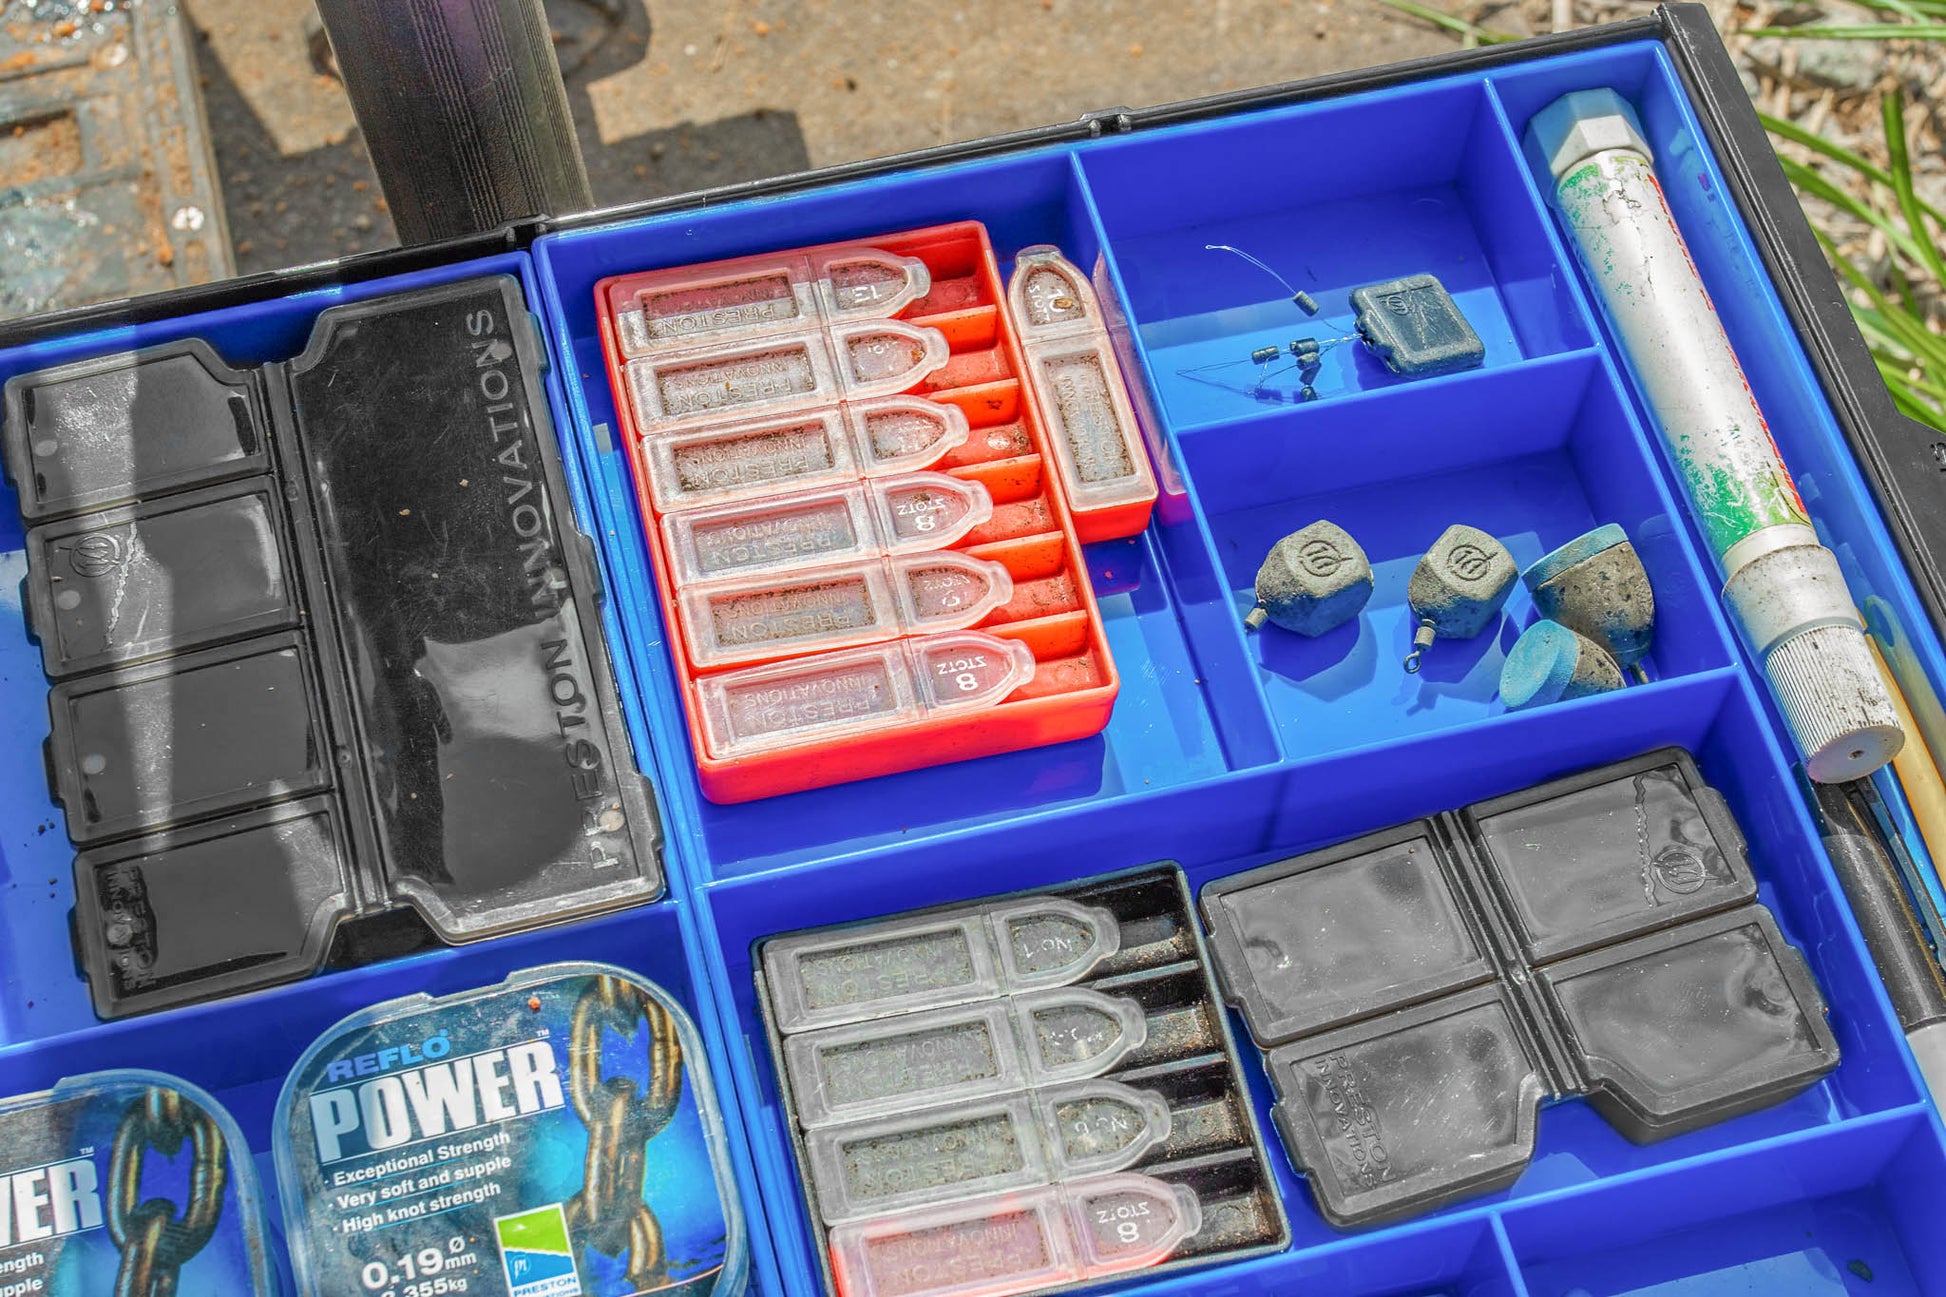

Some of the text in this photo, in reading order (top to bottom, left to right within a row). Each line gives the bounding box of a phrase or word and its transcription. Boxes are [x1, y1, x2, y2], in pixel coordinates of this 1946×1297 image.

[660, 303, 774, 334] PRESTON
[675, 378, 792, 407] PRESTON
[466, 310, 567, 617] INNOVATIONS
[692, 455, 809, 484] PRESTON
[914, 513, 936, 531] 8
[728, 609, 851, 640] PRESTON
[955, 671, 978, 691] 8
[541, 638, 619, 869] PRESTON
[310, 1040, 565, 1163] POWER
[1315, 1059, 1377, 1190] INNOVATIONS
[1329, 1053, 1396, 1183] PRESTON
[333, 1132, 511, 1187] Exceptional Strength
[336, 1156, 512, 1209] Very soft and supple
[342, 1182, 501, 1233] High knot strength
[1116, 1221, 1139, 1243] 8
